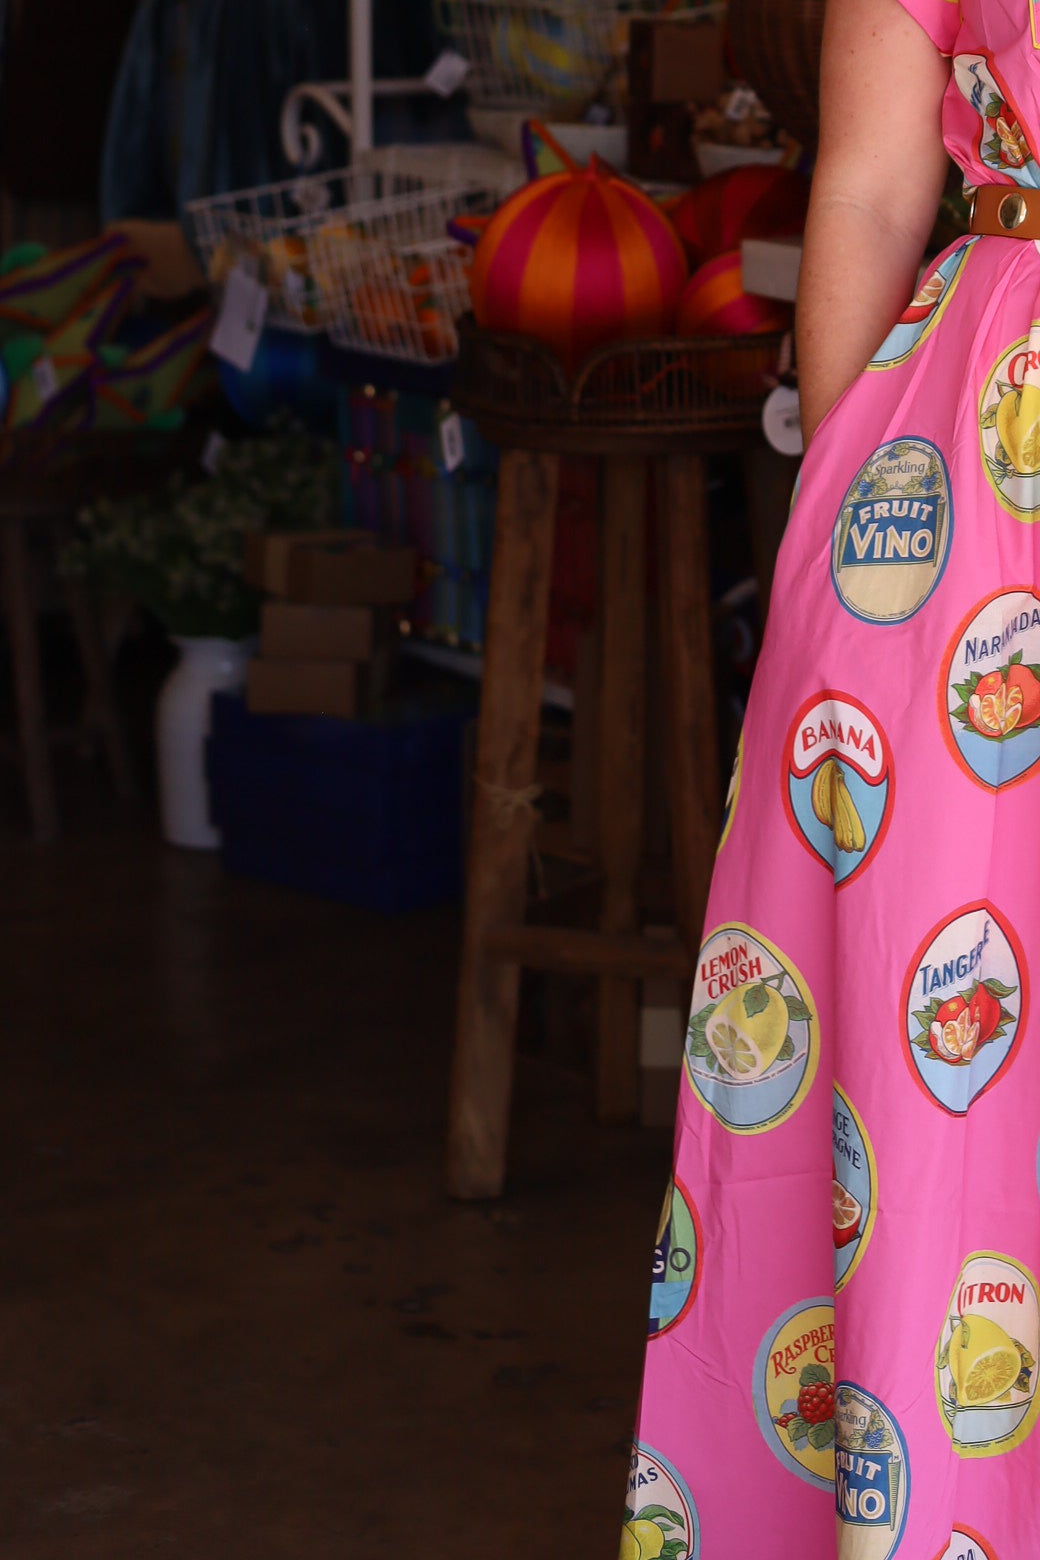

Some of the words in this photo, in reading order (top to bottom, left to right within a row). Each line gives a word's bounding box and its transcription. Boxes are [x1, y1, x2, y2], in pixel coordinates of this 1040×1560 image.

[875, 460, 926, 477] Sparkling
[858, 500, 934, 525] FRUIT
[850, 522, 934, 560] VINO
[801, 719, 877, 761] BANANA
[700, 941, 748, 983] LEMON
[707, 956, 763, 1000] CRUSH
